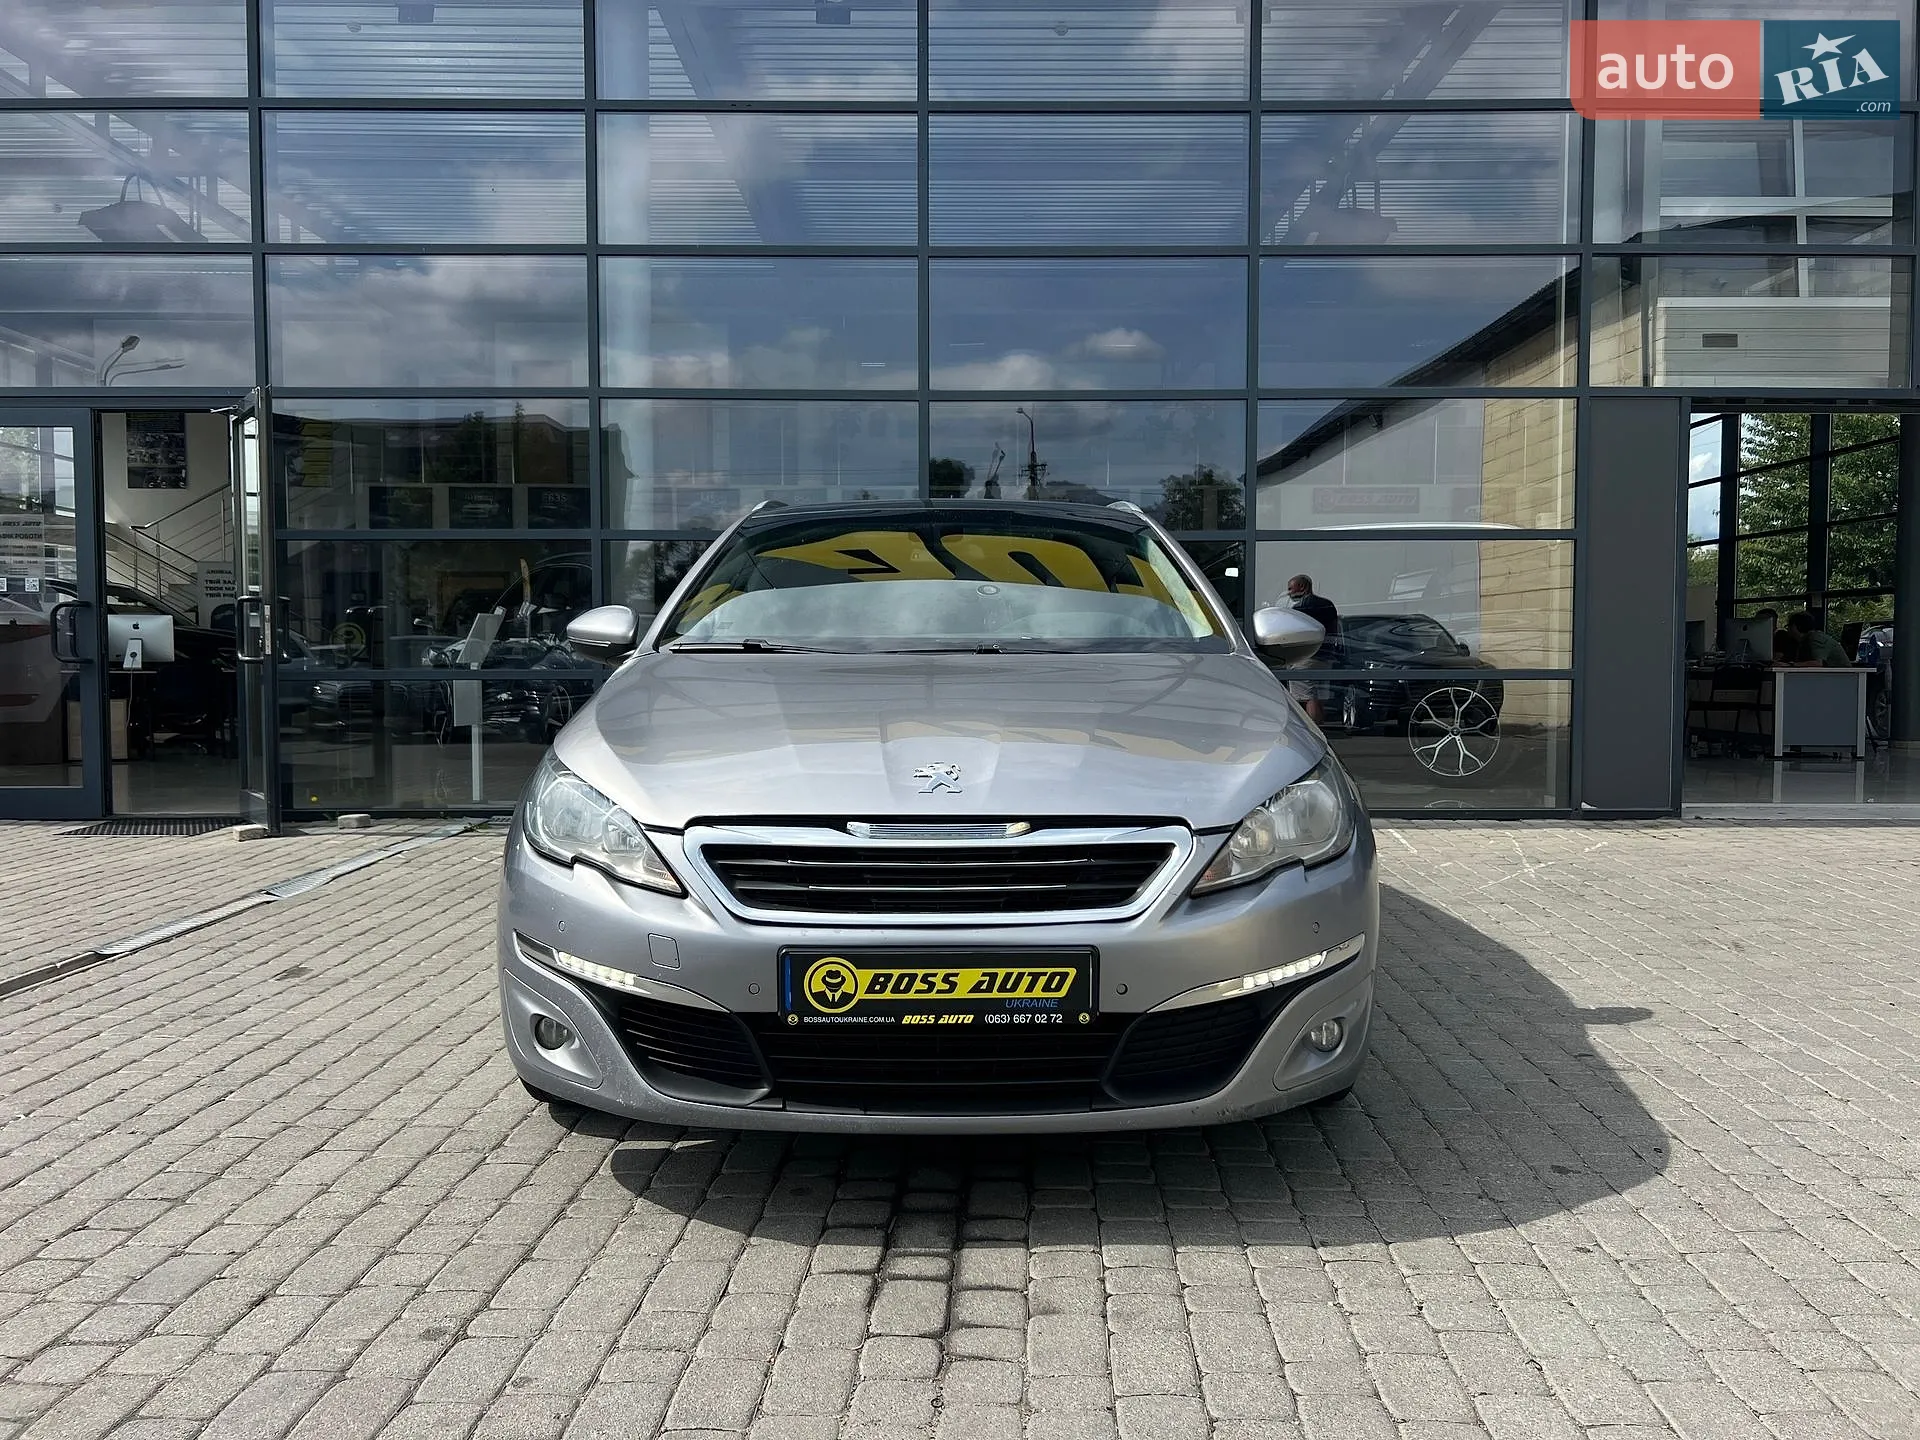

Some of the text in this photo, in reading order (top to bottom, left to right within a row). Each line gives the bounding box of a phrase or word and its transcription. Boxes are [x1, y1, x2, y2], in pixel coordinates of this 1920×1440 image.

[864, 971, 1070, 995] BOSS AUTO
[1004, 999, 1059, 1008] UKRAINE
[803, 1016, 896, 1024] BOSSAUTOUKRAINE.COM.UA
[901, 1014, 975, 1025] BOSS AUTO
[984, 1014, 1063, 1024] (063) 667 02 72
